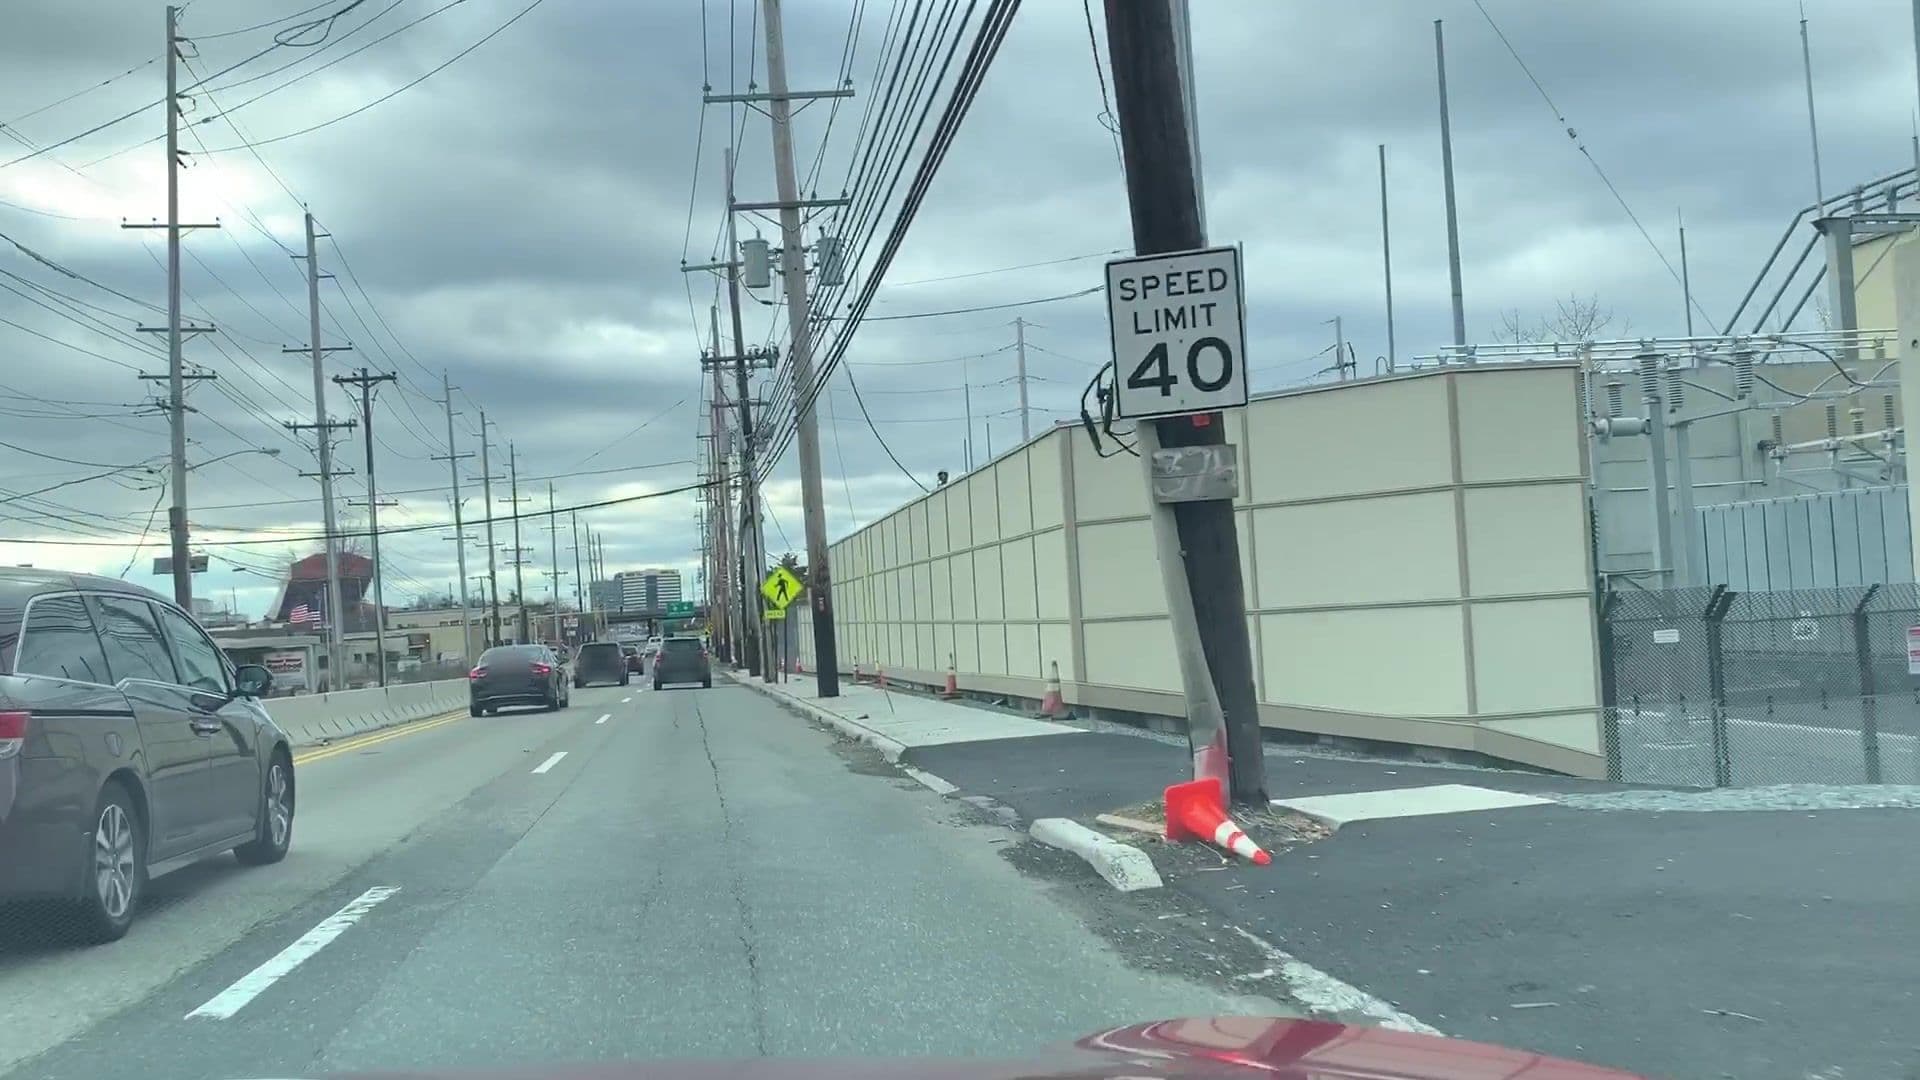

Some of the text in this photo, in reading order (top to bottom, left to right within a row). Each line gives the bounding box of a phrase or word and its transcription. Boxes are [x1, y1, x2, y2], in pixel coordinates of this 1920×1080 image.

[1119, 268, 1228, 300] SPEED
[1133, 303, 1217, 334] LIMIT
[1127, 336, 1233, 396] 40
